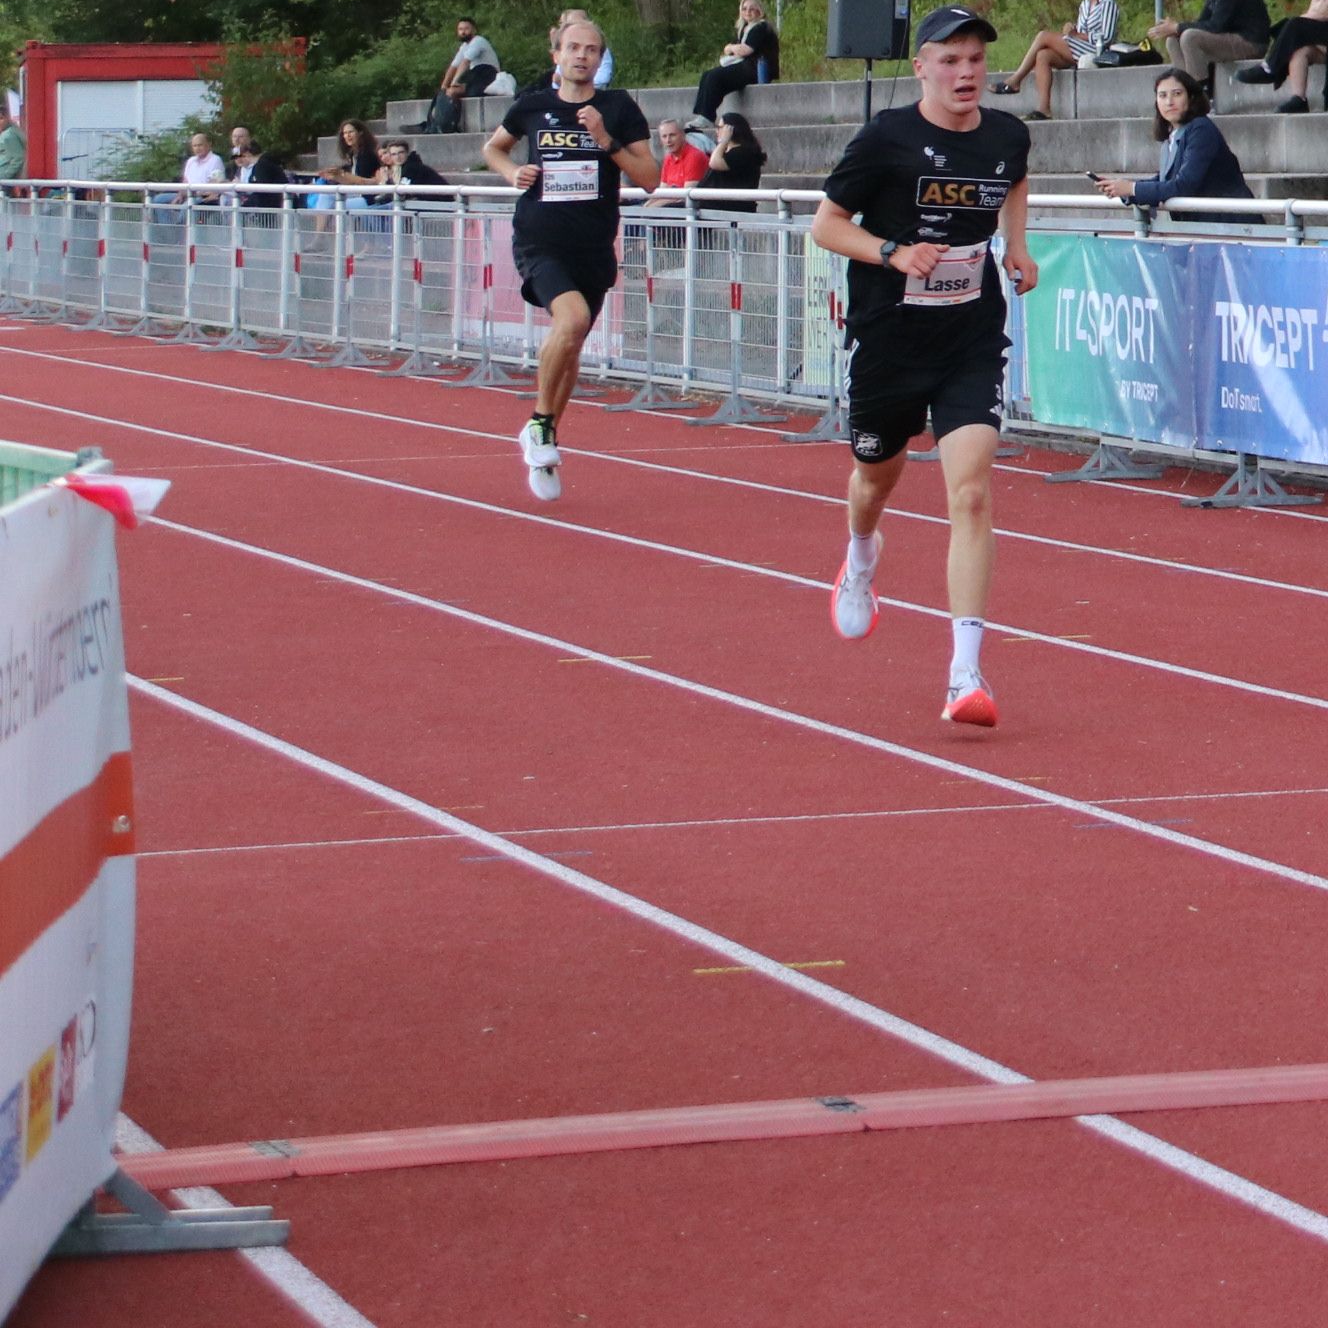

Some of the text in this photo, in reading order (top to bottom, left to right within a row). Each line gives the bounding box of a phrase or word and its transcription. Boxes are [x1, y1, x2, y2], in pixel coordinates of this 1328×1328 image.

[540, 132, 578, 147] ASC
[544, 182, 594, 192] Sebastian
[921, 183, 976, 205] ASC
[925, 277, 970, 291] Lasse
[1215, 301, 1318, 370] TRICEPT
